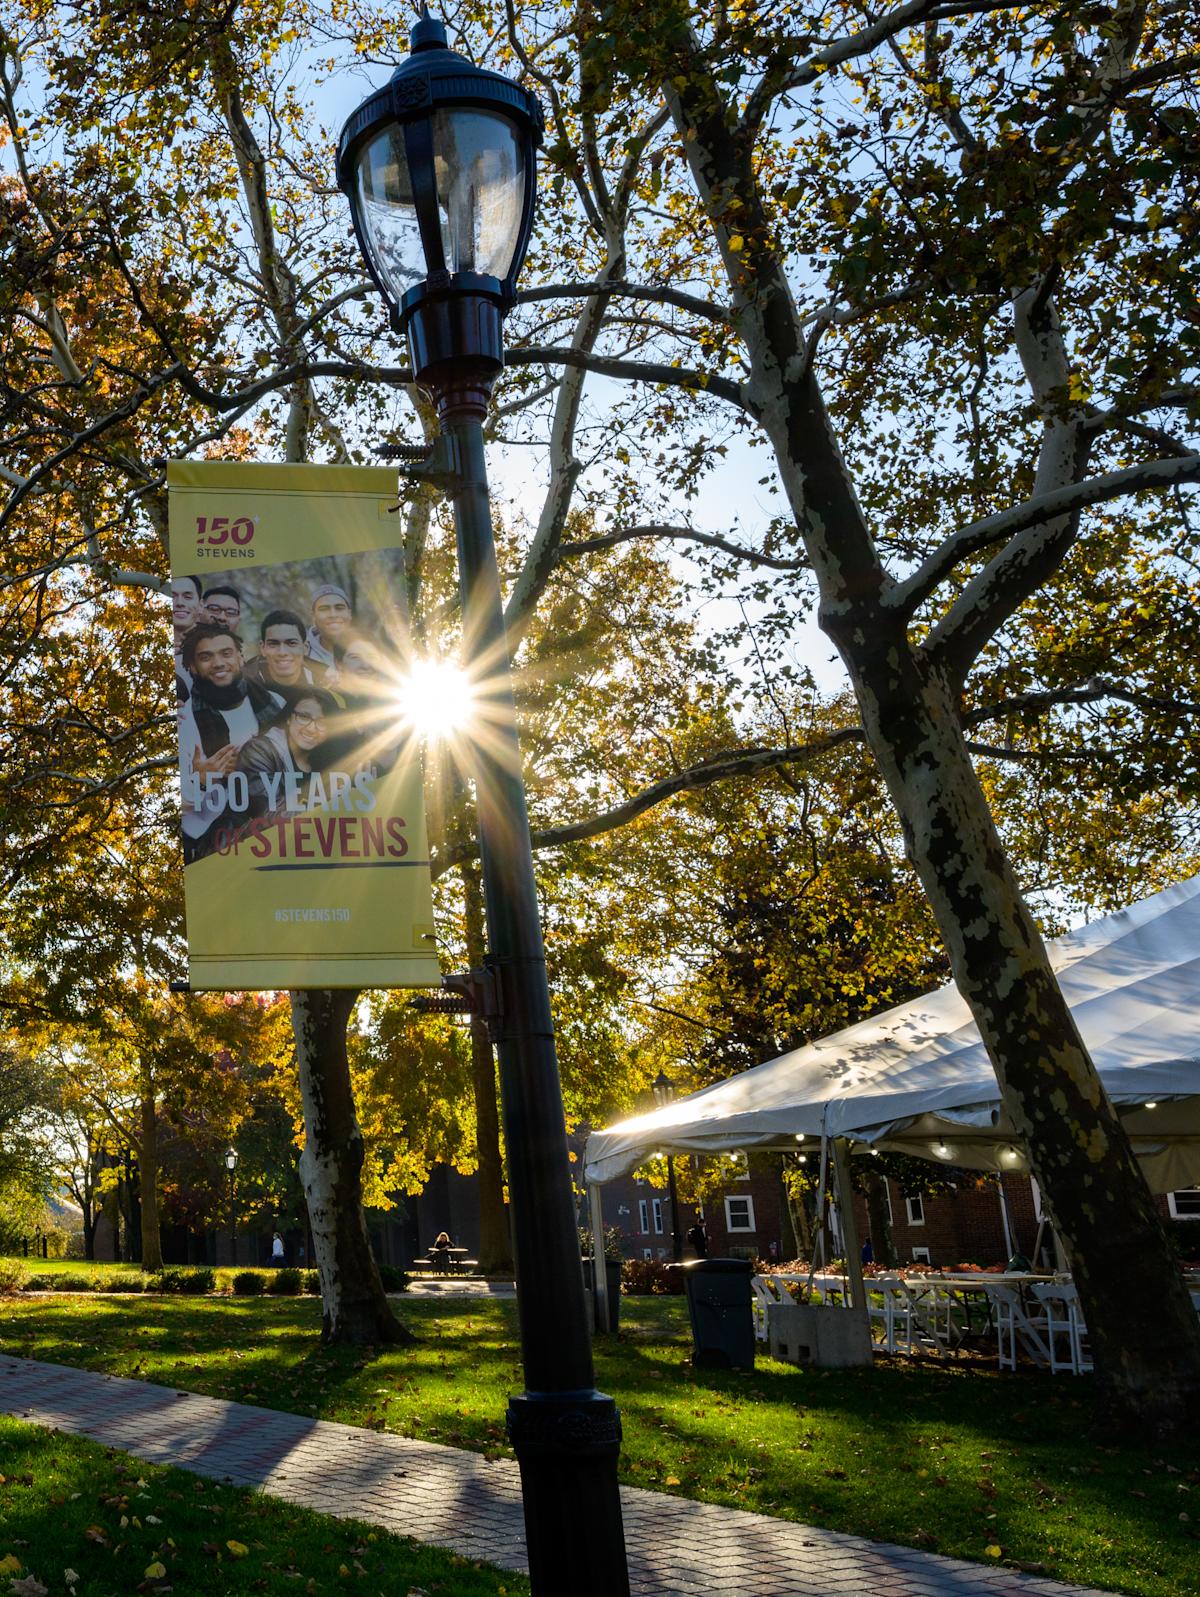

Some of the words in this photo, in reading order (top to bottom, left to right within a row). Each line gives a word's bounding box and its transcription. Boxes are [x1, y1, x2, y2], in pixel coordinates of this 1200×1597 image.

[196, 517, 254, 545] 150
[196, 548, 255, 558] STEVENS
[191, 771, 249, 812] 150
[259, 771, 377, 812] YEARS
[250, 816, 409, 858] STEVENS
[275, 909, 350, 922] #STEVENS150
